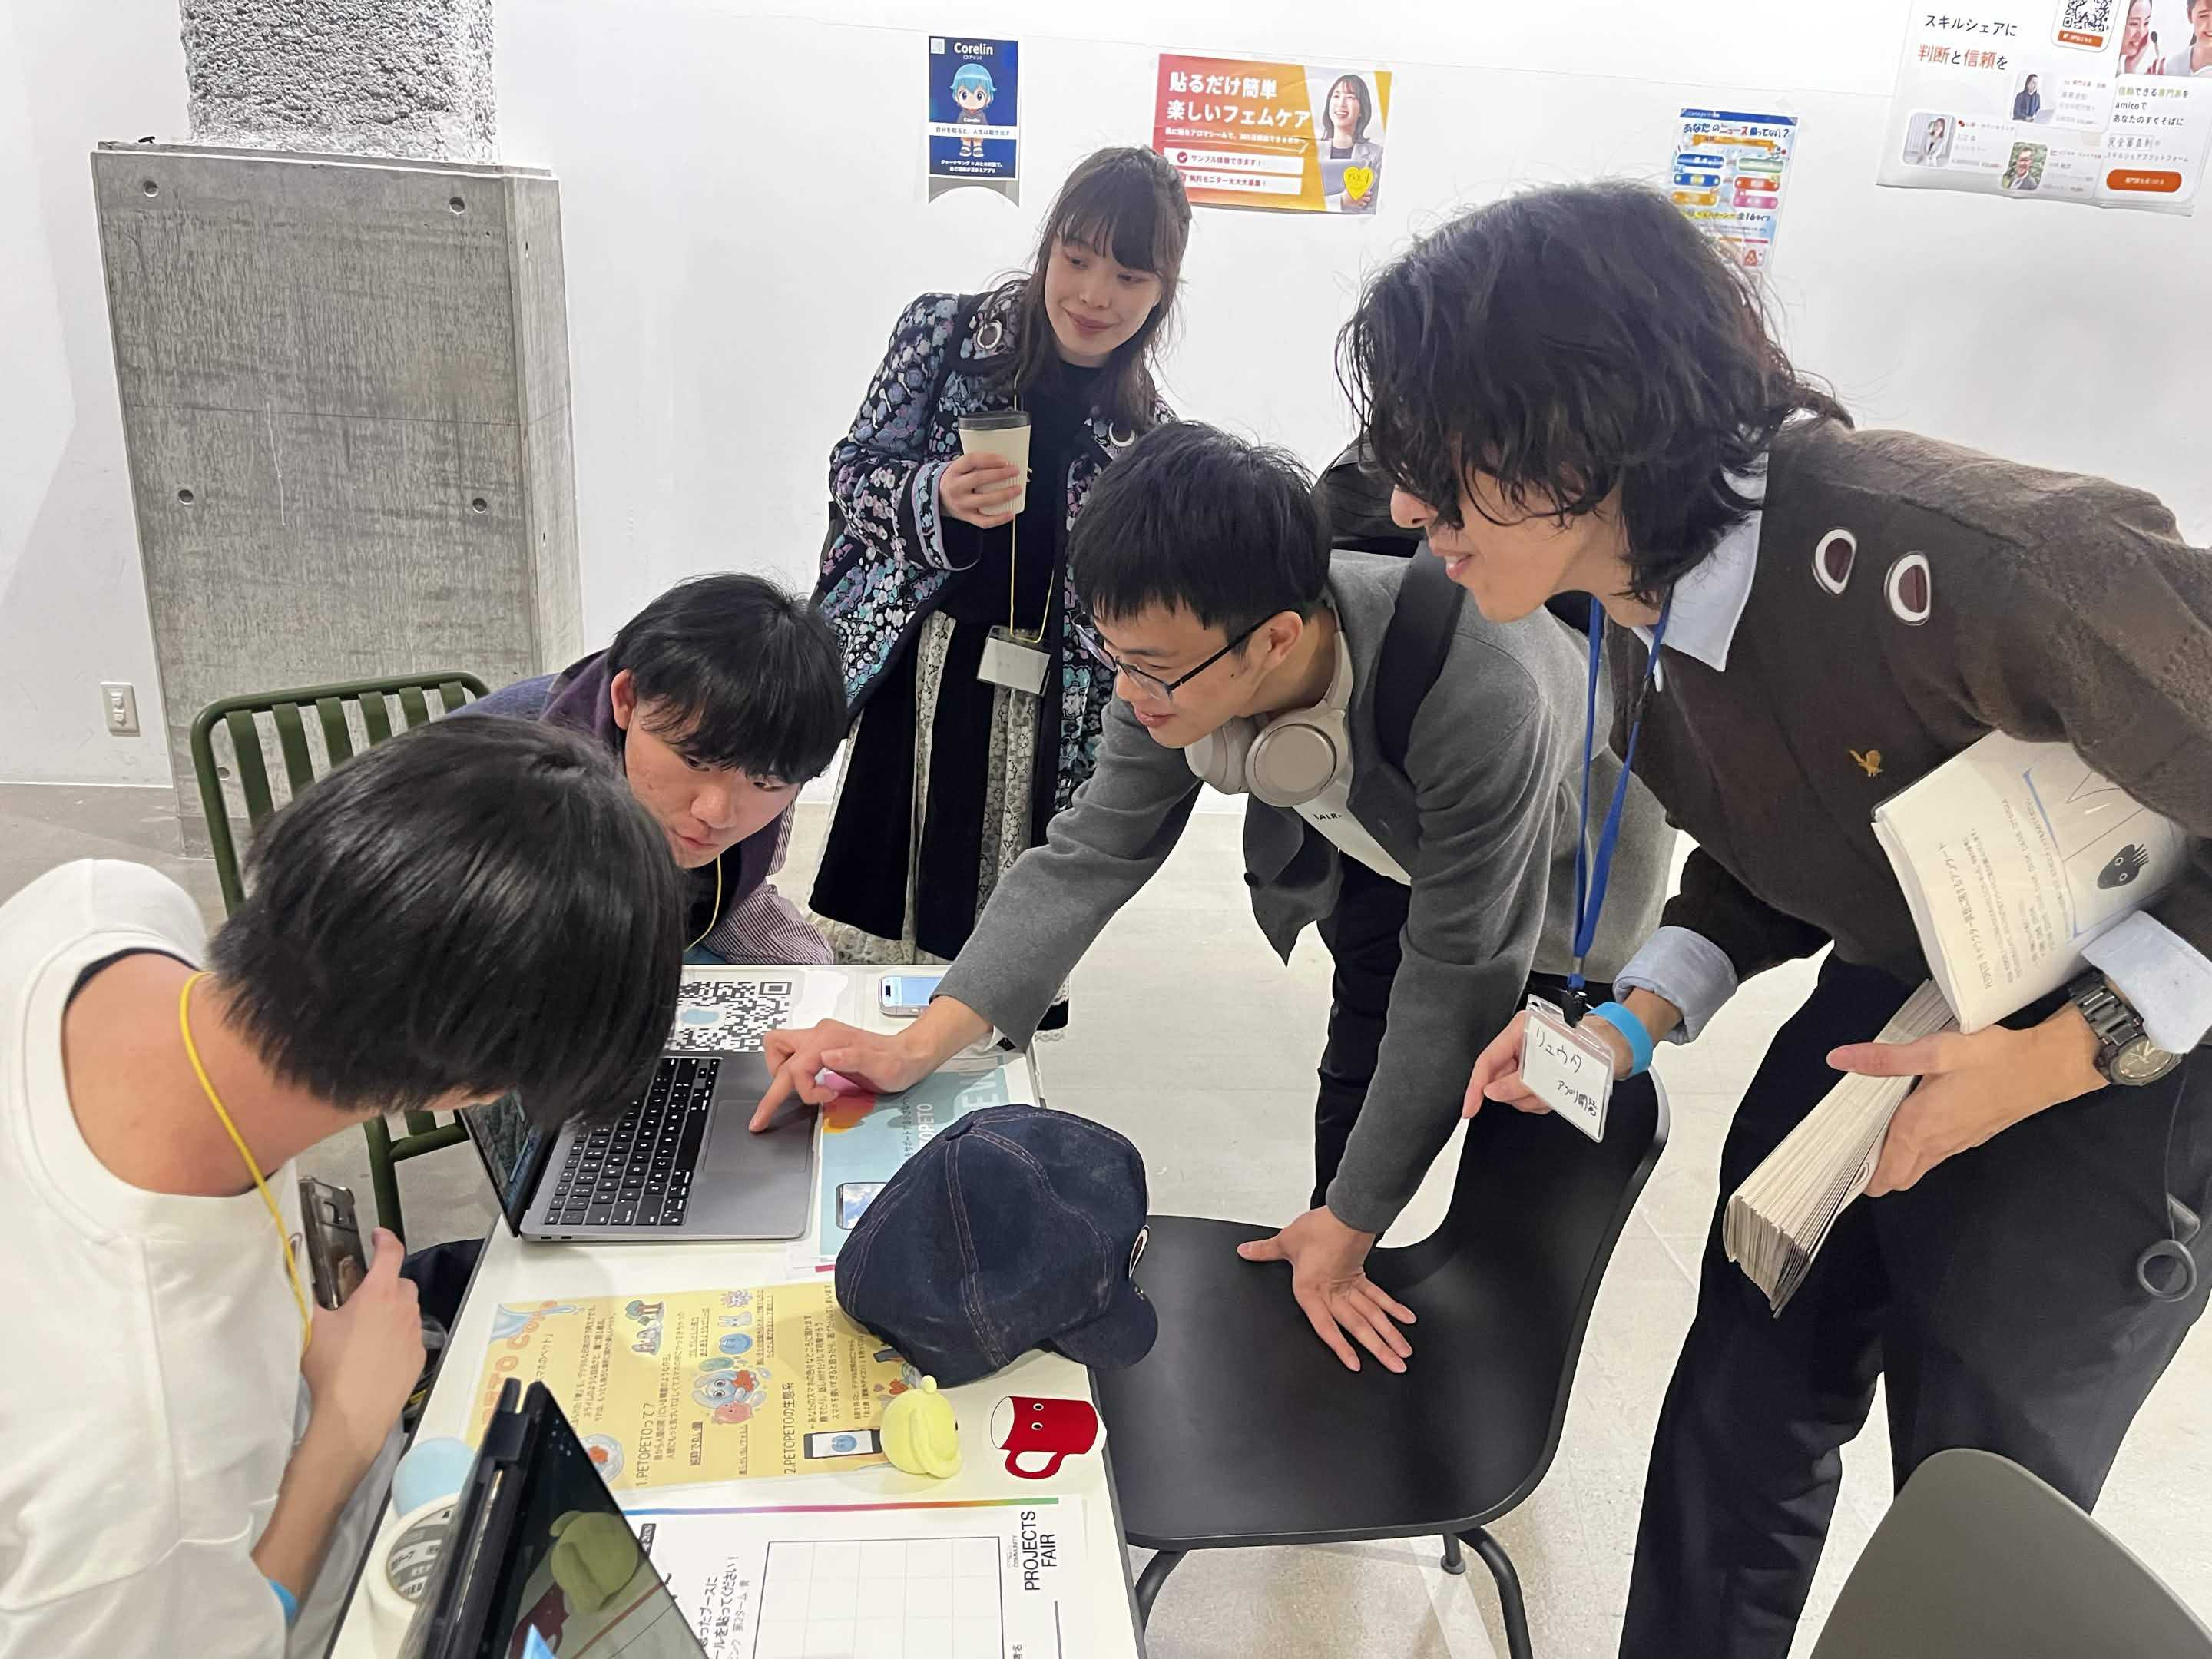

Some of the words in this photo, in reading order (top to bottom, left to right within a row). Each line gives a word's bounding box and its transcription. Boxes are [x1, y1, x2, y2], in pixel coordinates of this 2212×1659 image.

[1924, 14, 2018, 36] スキルシェアに
[953, 41, 994, 56] Corelin
[1918, 44, 2008, 71] 判断と信頼を
[1168, 71, 1278, 100] 貼るだけ簡単
[1166, 99, 1311, 128] 楽しいフェムケア
[535, 1333, 554, 1379] マホのペット」
[781, 1382, 797, 1474] 2.PETOPETOの生態系
[636, 1402, 654, 1487] 1.PETOPETOって？
[1021, 1511, 1040, 1591] PROJECTS
[1040, 1534, 1058, 1568] FAIR
